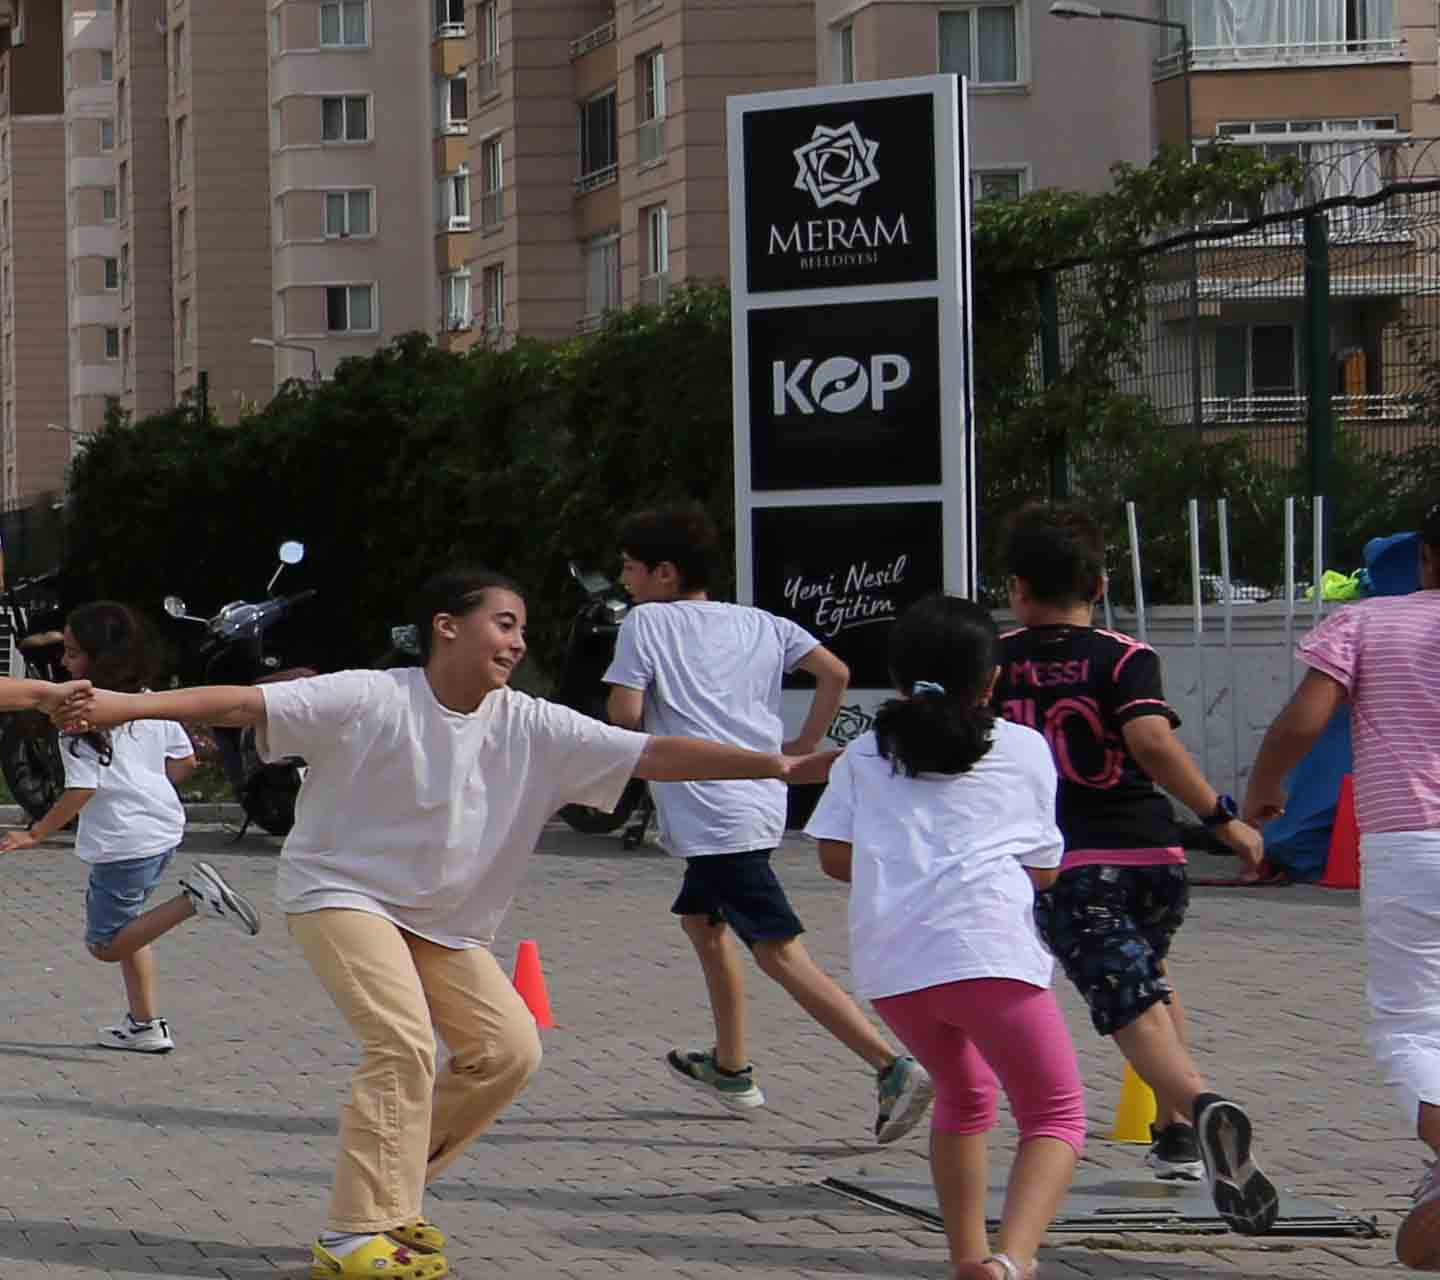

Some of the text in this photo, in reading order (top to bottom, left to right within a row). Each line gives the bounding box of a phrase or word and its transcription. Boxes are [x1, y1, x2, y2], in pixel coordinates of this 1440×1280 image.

[767, 211, 912, 256] MERAM
[772, 353, 911, 416] KOP
[784, 554, 907, 608] Yeni Nesil
[815, 594, 896, 637] Eğitim
[1010, 659, 1089, 687] MESSI
